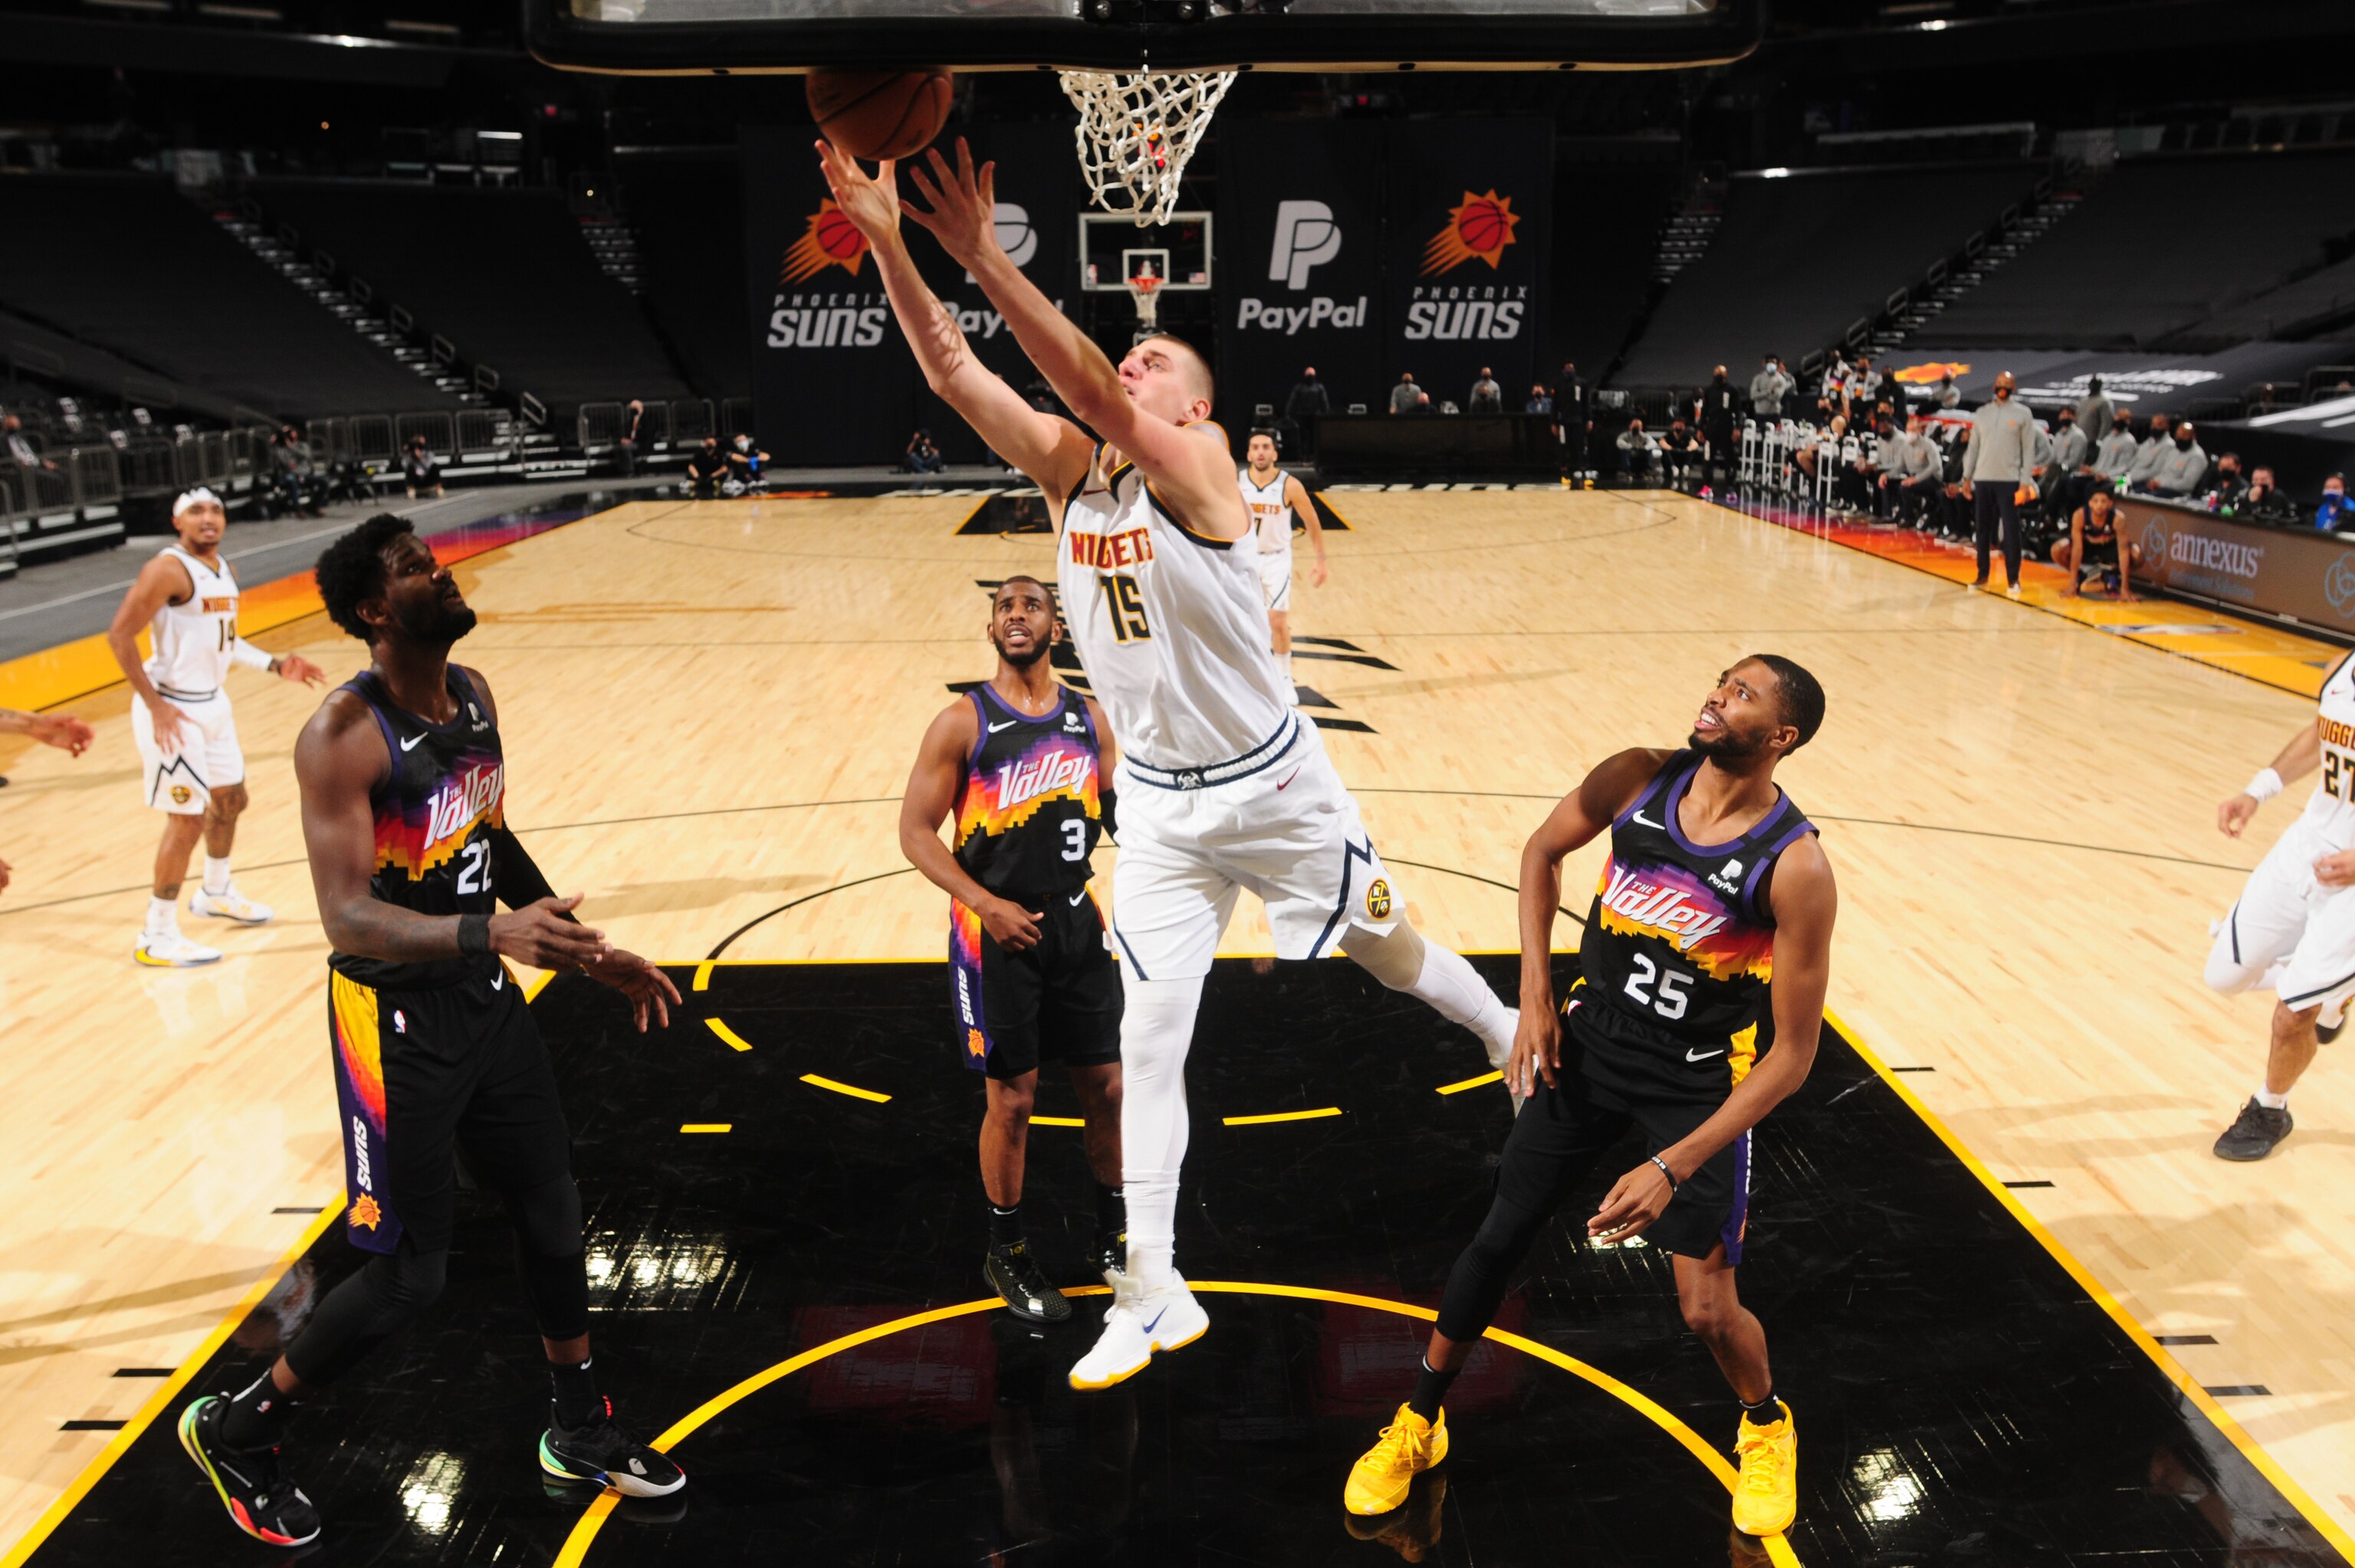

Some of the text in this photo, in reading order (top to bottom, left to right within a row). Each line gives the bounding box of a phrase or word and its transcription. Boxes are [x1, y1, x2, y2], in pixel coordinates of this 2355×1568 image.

[774, 293, 888, 307] PHOENIX
[1413, 286, 1528, 300] PHOENIX
[767, 308, 887, 347] SUNS
[1237, 296, 1368, 336] PayPal
[1404, 301, 1524, 340] SUNS
[1100, 576, 1152, 644] 15
[997, 750, 1092, 811] Valley
[1022, 760, 1040, 774] THE
[2324, 749, 2355, 805] 27
[424, 763, 504, 851] Valley
[1059, 818, 1086, 862] 3
[1631, 881, 1657, 895] THE
[1707, 873, 1739, 896] PayPal
[1601, 865, 1728, 951] Valley
[1624, 952, 1694, 1020] 25
[353, 1115, 373, 1192] SUNS
